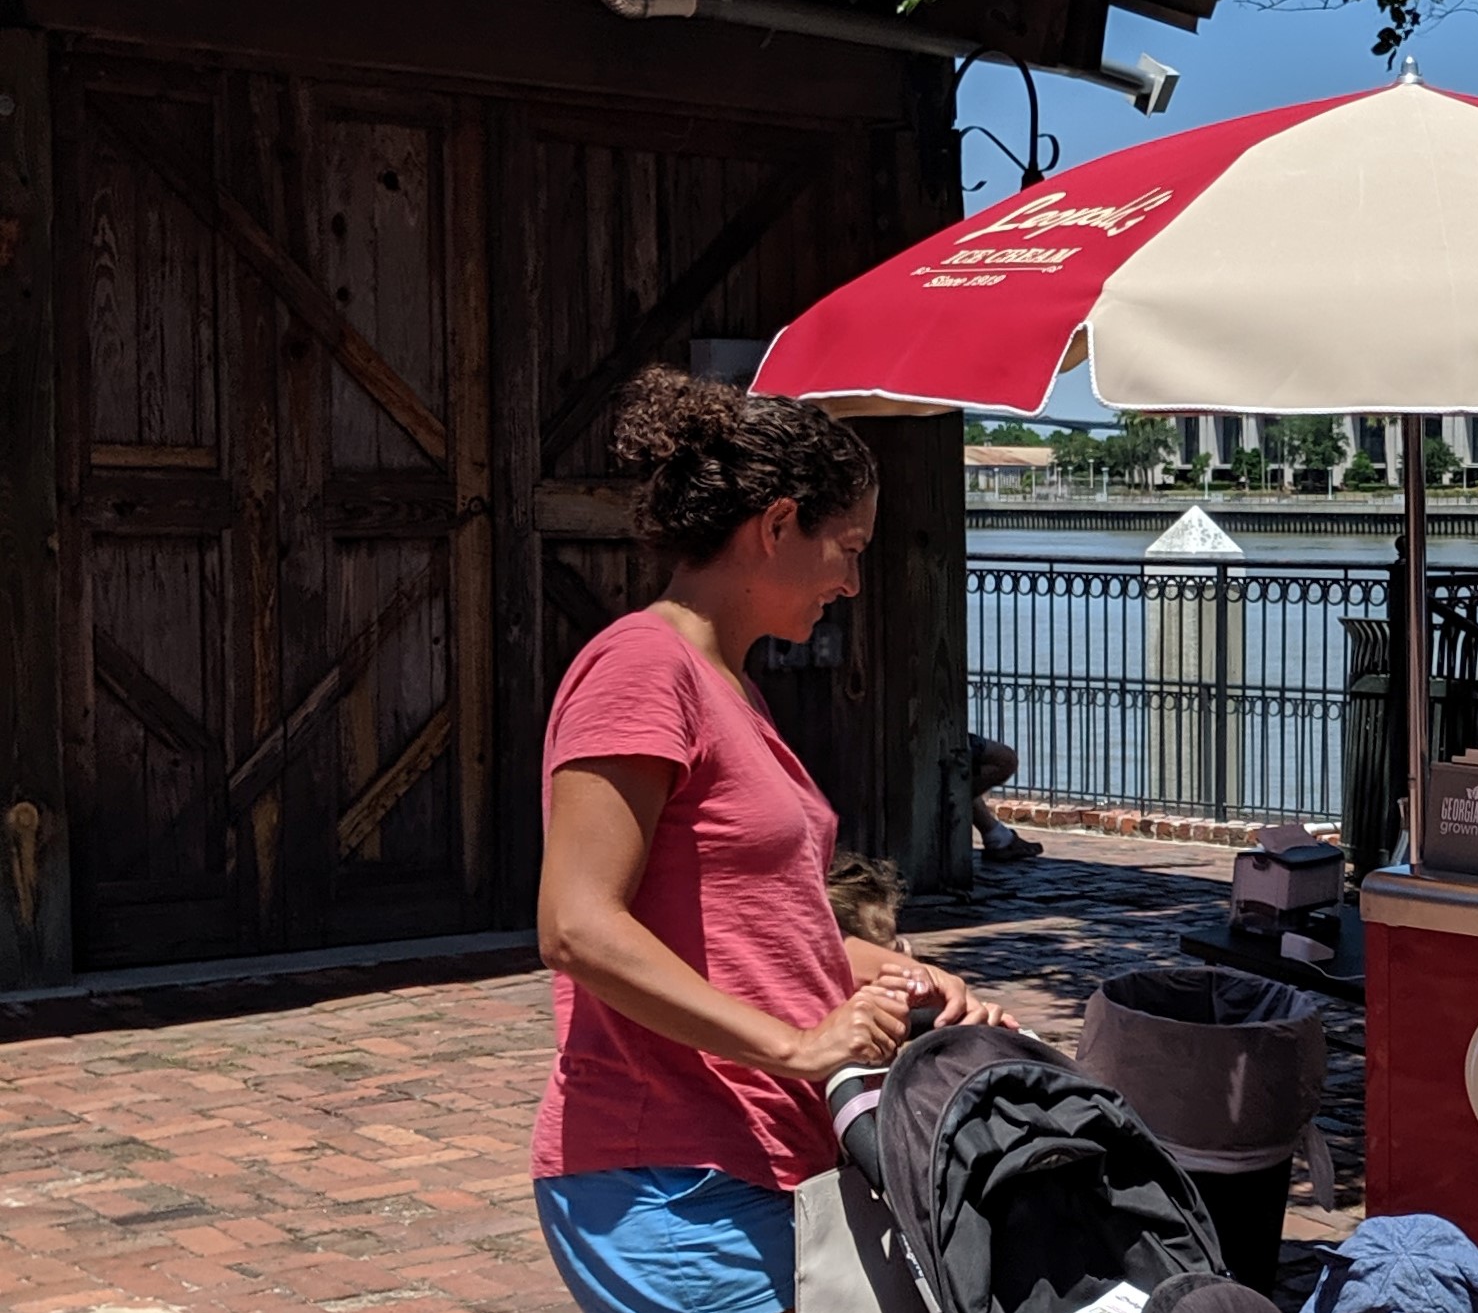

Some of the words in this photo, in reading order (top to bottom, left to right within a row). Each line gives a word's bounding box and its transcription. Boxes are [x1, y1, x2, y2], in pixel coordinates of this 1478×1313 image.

[953, 186, 1175, 246] Leopold's
[940, 247, 991, 265] ICE
[984, 246, 1083, 264] CREAM
[1440, 821, 1478, 836] grown
